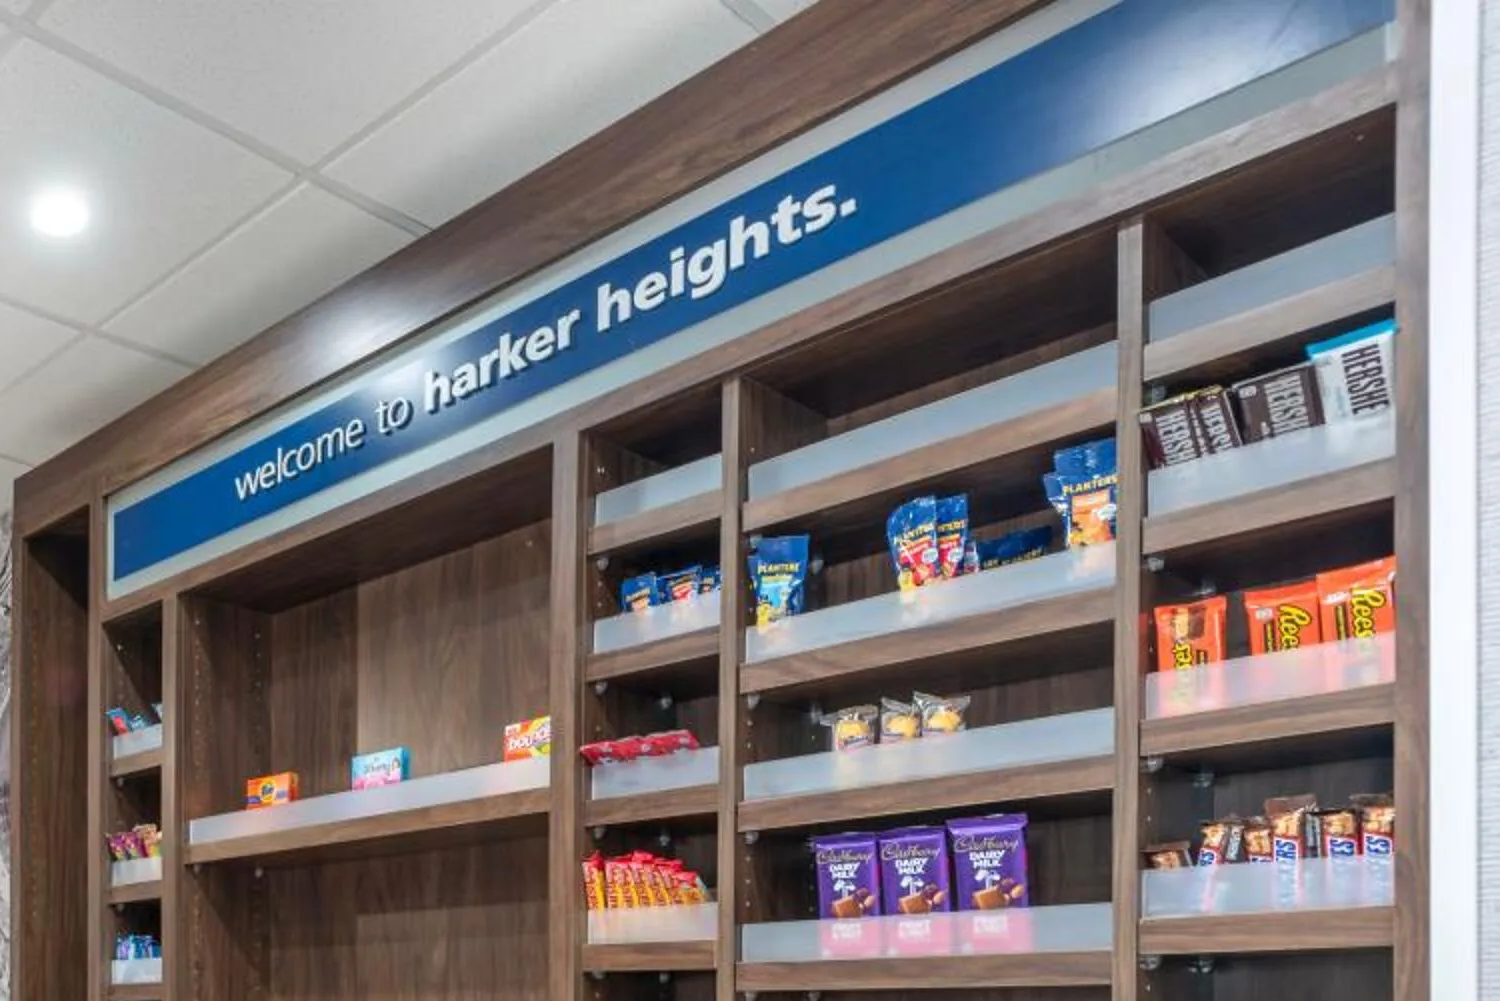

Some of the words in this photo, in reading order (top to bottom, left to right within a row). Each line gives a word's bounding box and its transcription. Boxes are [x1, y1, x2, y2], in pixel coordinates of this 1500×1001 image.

[234, 417, 364, 500] welcome
[376, 394, 411, 435] to
[424, 308, 580, 413] harker
[597, 183, 856, 331] heights.
[1265, 374, 1310, 435] HERSH
[1155, 408, 1199, 466] HERSH
[970, 850, 1005, 861] DAIRY
[829, 862, 861, 872] DAIRY
[895, 858, 928, 869] DAIRY
[973, 858, 1001, 868] MILK
[832, 870, 857, 879] MILK
[899, 865, 925, 875] MILK
